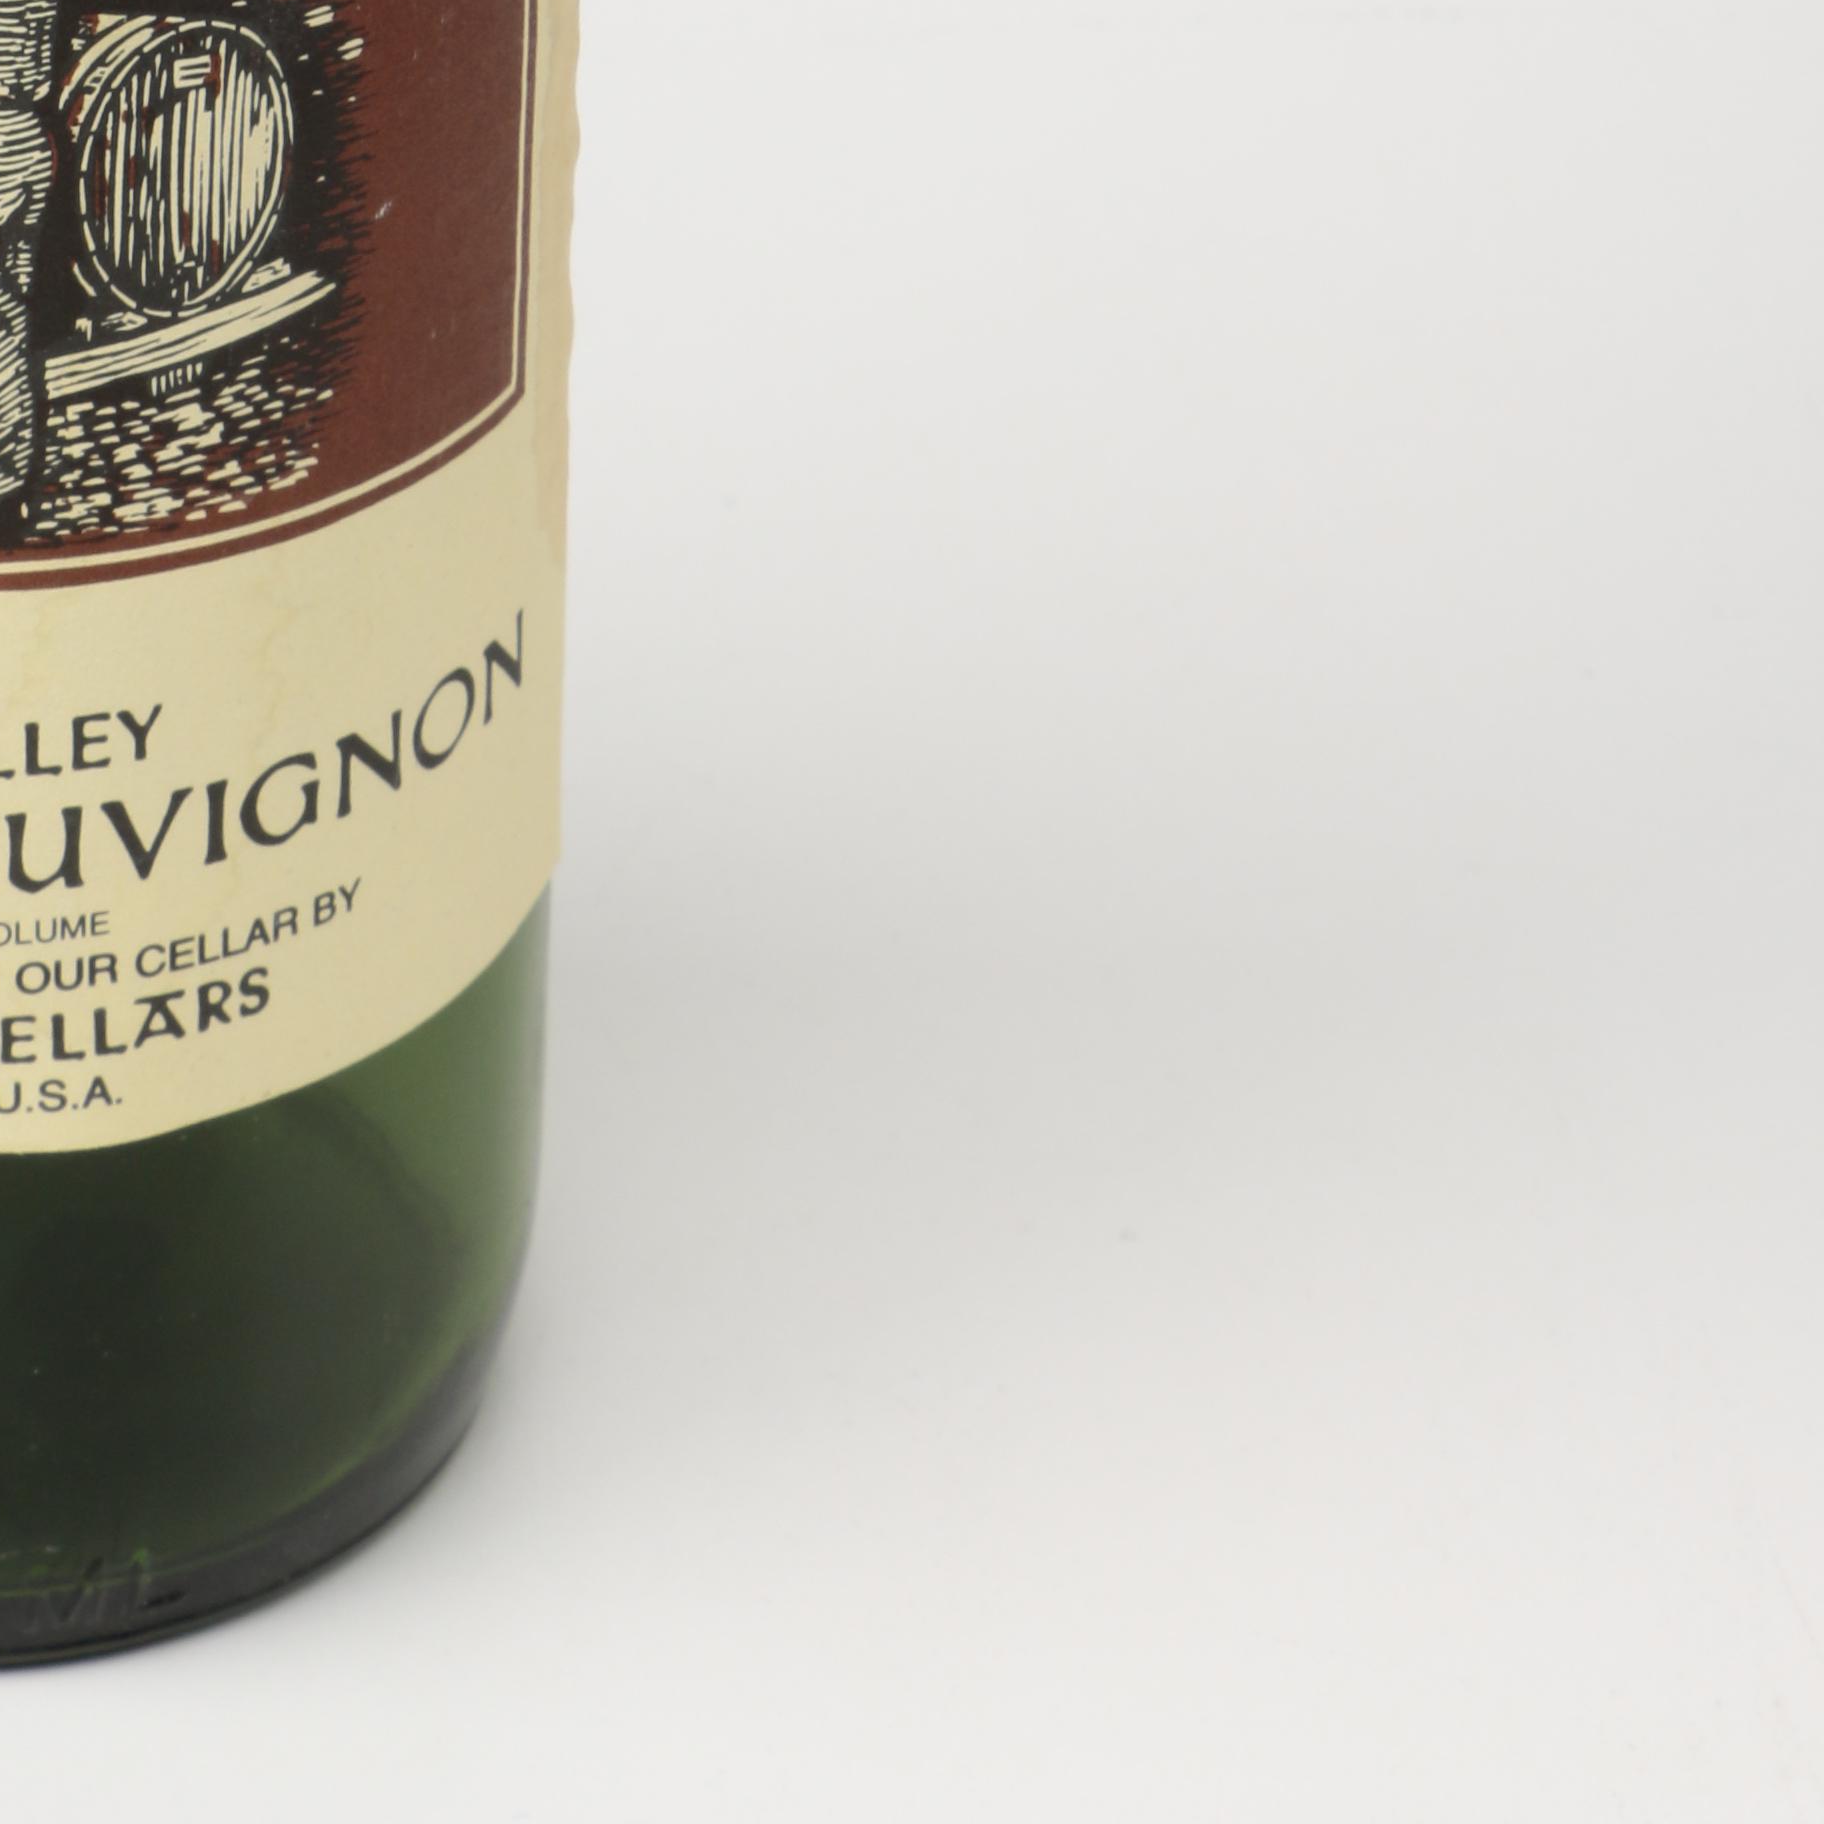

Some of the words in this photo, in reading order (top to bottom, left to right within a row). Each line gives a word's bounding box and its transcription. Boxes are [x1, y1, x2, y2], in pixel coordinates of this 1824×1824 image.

[14, 952, 119, 995] OUR
[135, 904, 300, 978] CELLAR
[312, 877, 363, 928] BY
